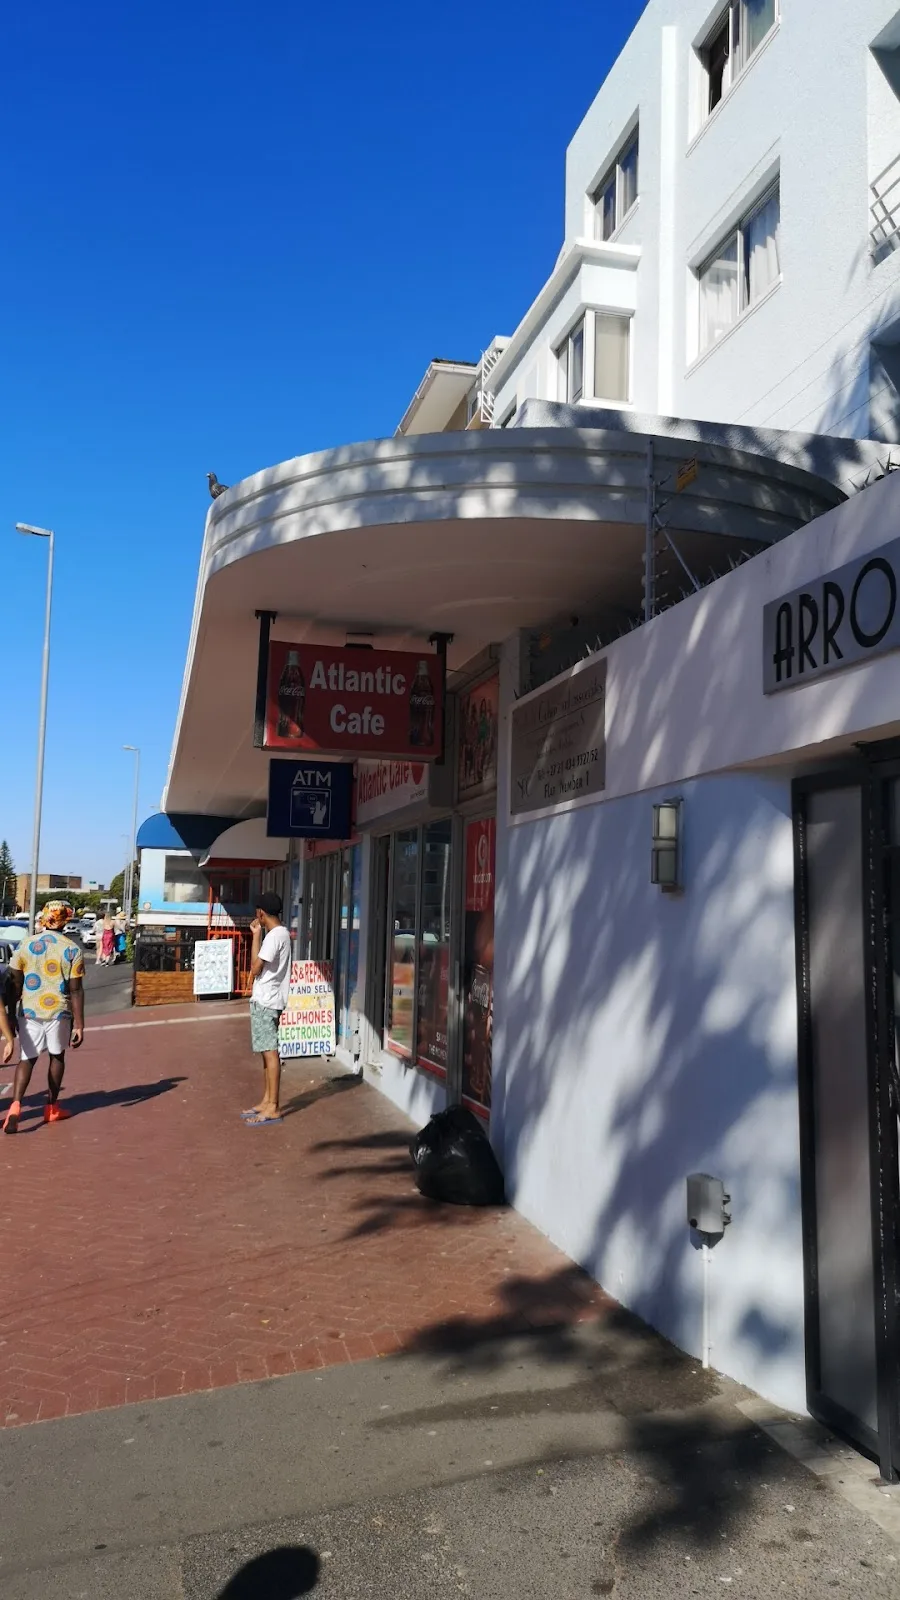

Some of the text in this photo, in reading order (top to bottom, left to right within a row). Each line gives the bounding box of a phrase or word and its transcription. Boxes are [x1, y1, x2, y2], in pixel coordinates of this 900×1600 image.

[773, 557, 897, 683] ARRO
[309, 660, 406, 695] Atlantic
[330, 704, 385, 736] Cafe
[292, 769, 332, 787] ATM
[358, 761, 387, 806] Atlantic
[299, 967, 304, 980] &
[304, 961, 333, 984] REPAIRS
[296, 985, 311, 995] AND
[314, 984, 332, 994] SELL
[281, 1010, 333, 1026] ELLPHONES
